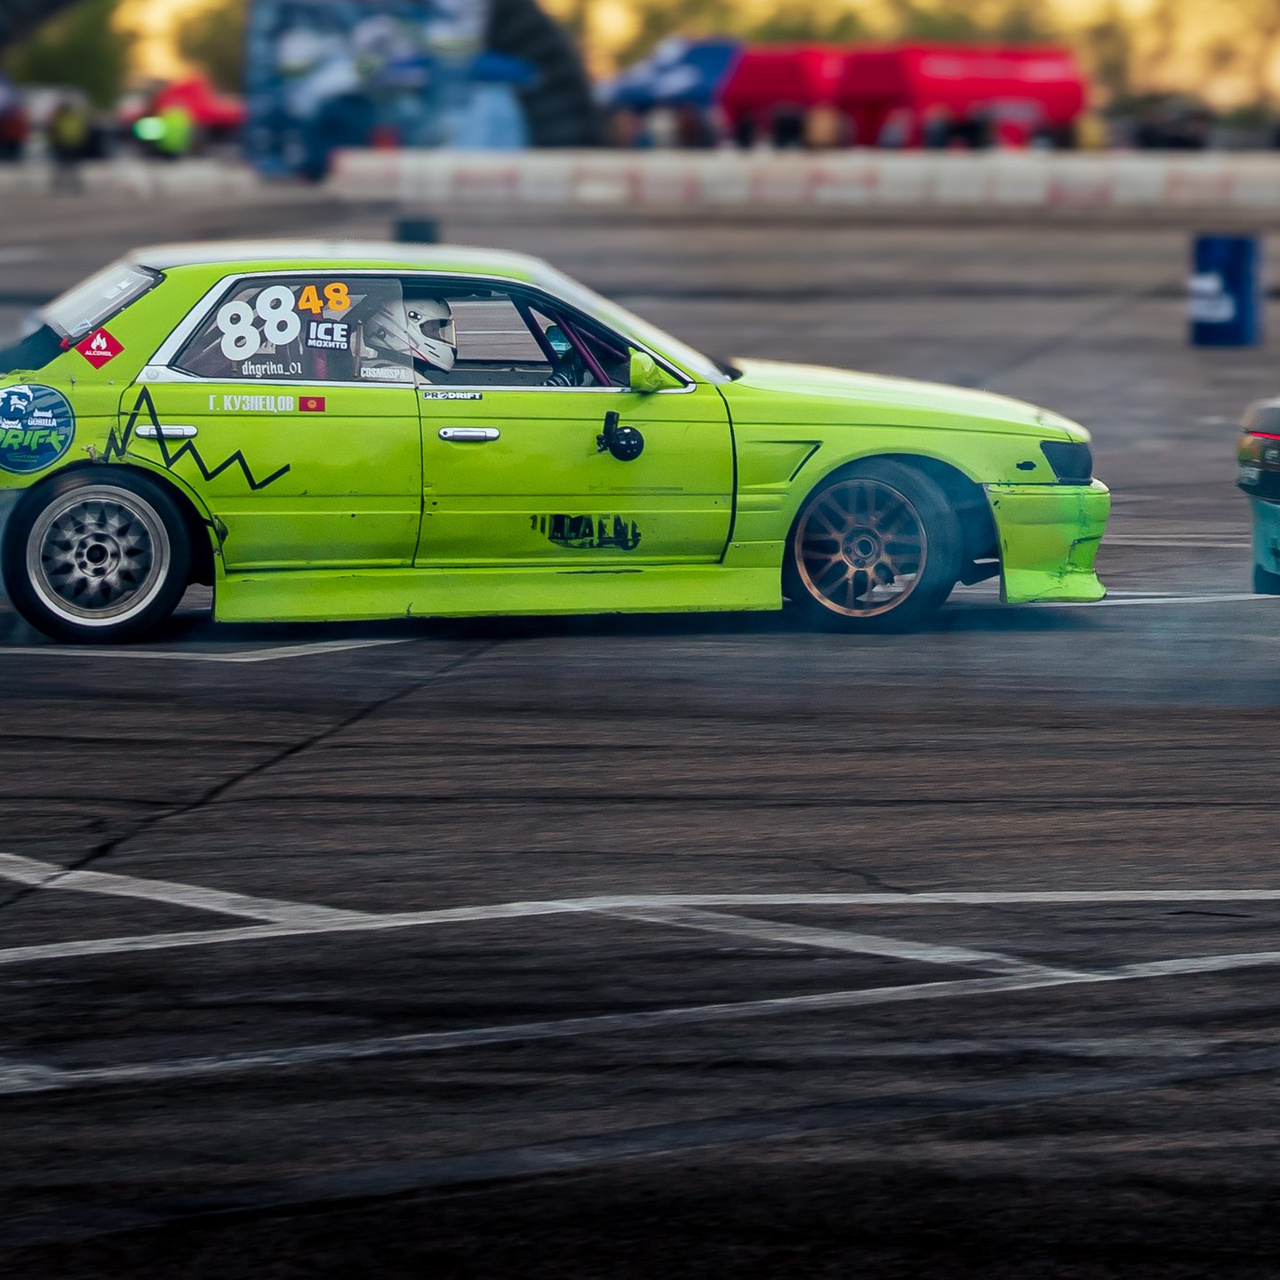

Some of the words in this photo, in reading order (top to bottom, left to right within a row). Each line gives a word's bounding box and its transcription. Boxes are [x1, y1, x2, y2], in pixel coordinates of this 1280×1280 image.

[298, 282, 351, 314] 48
[216, 285, 301, 361] 88
[309, 321, 348, 342] ICE
[208, 394, 221, 411] Г.
[223, 395, 295, 413] КУЗНЕЦОВ
[27, 417, 58, 427] GORILLA
[0, 428, 65, 453] RIFT
